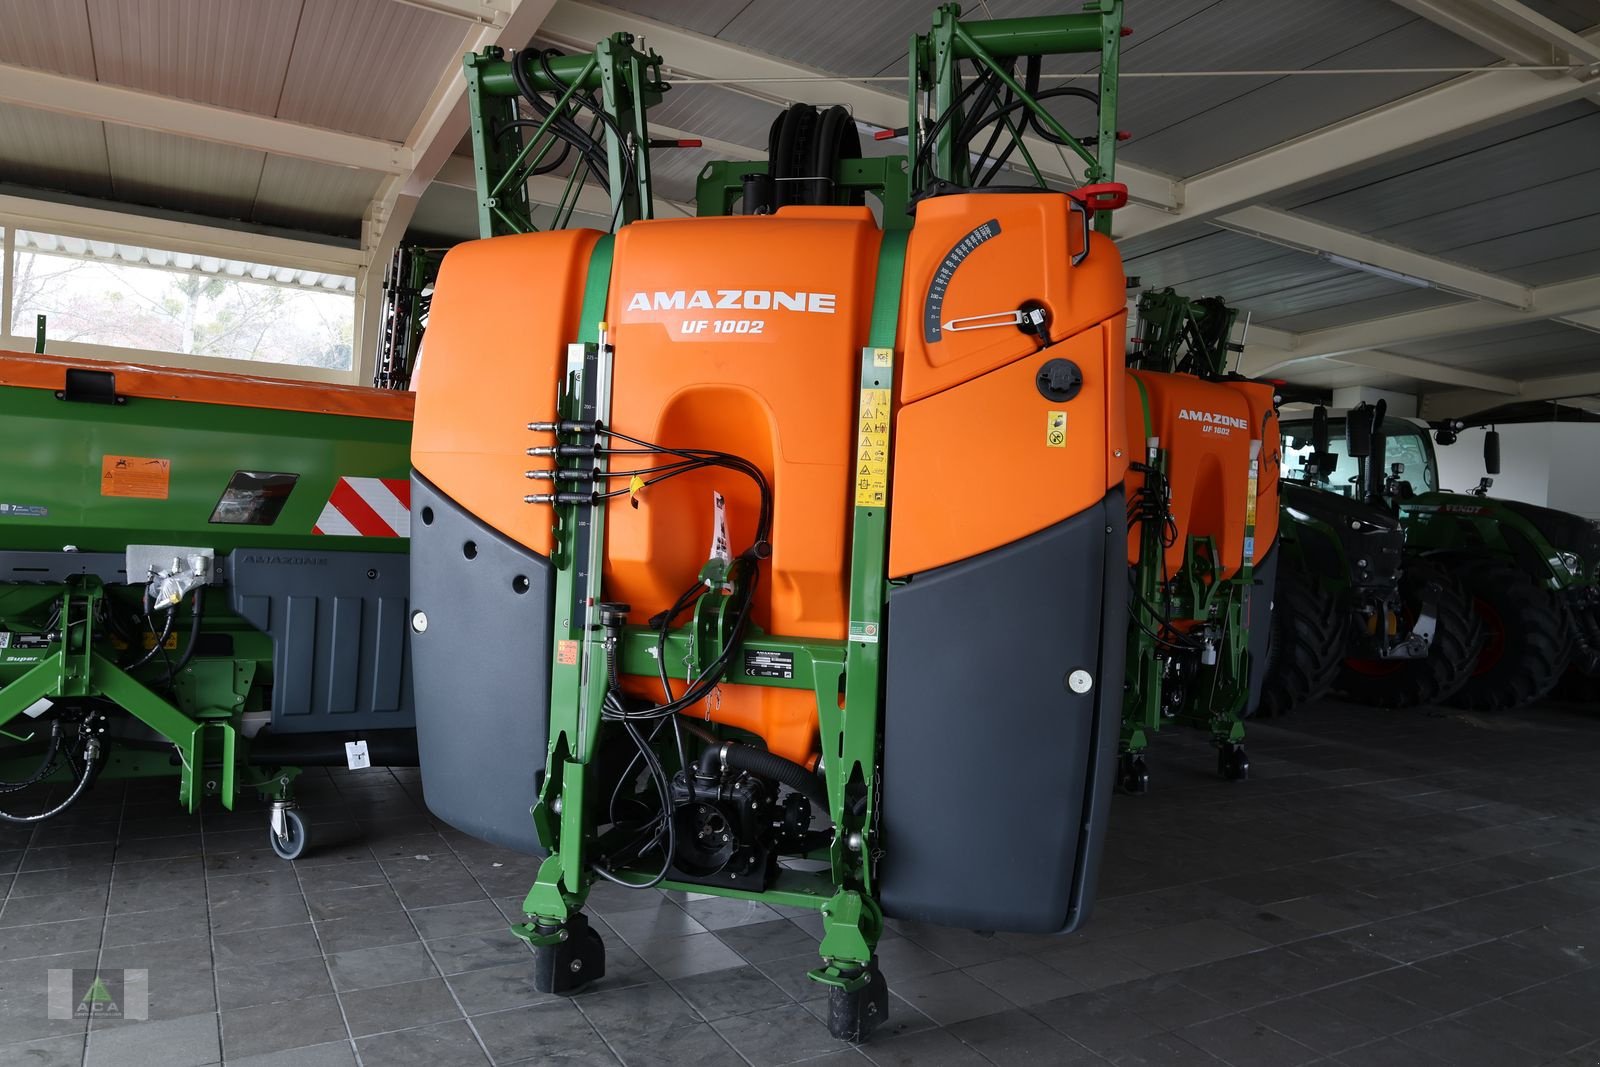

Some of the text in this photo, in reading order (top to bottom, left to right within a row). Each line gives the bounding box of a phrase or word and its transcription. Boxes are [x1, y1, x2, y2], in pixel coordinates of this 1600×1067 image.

[627, 290, 836, 314] AMAZONE
[681, 320, 764, 334] UF 1002
[1178, 409, 1248, 430] AMAZONE
[1202, 424, 1230, 436] UF 1602
[1446, 504, 1482, 513] FENDT
